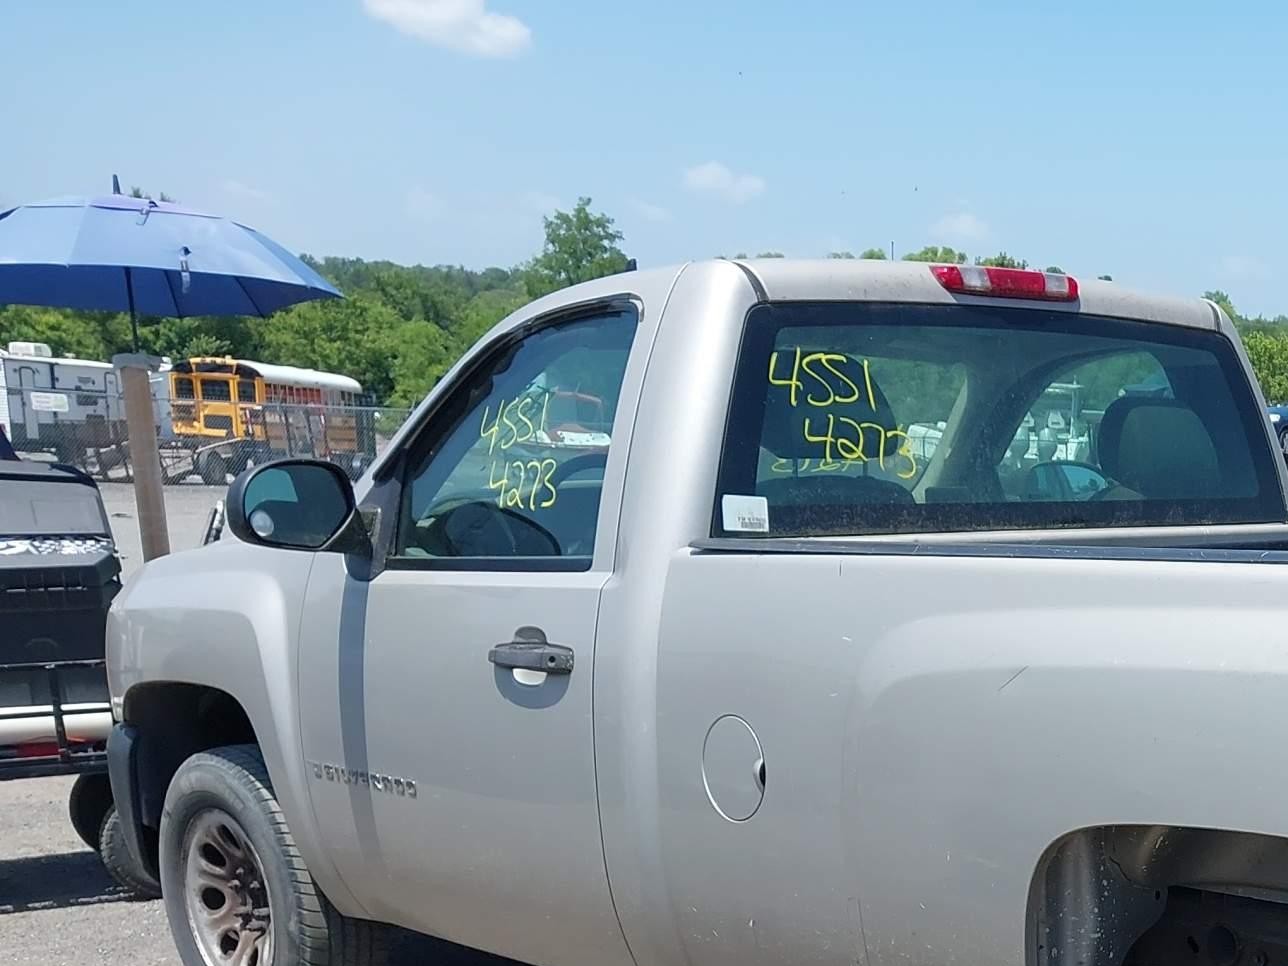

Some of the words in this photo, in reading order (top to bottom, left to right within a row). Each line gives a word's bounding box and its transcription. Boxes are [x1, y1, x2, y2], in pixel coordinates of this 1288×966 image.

[768, 347, 876, 412] 4551
[480, 391, 550, 456] 4551
[803, 413, 916, 479] 4273
[489, 458, 557, 512] 4273
